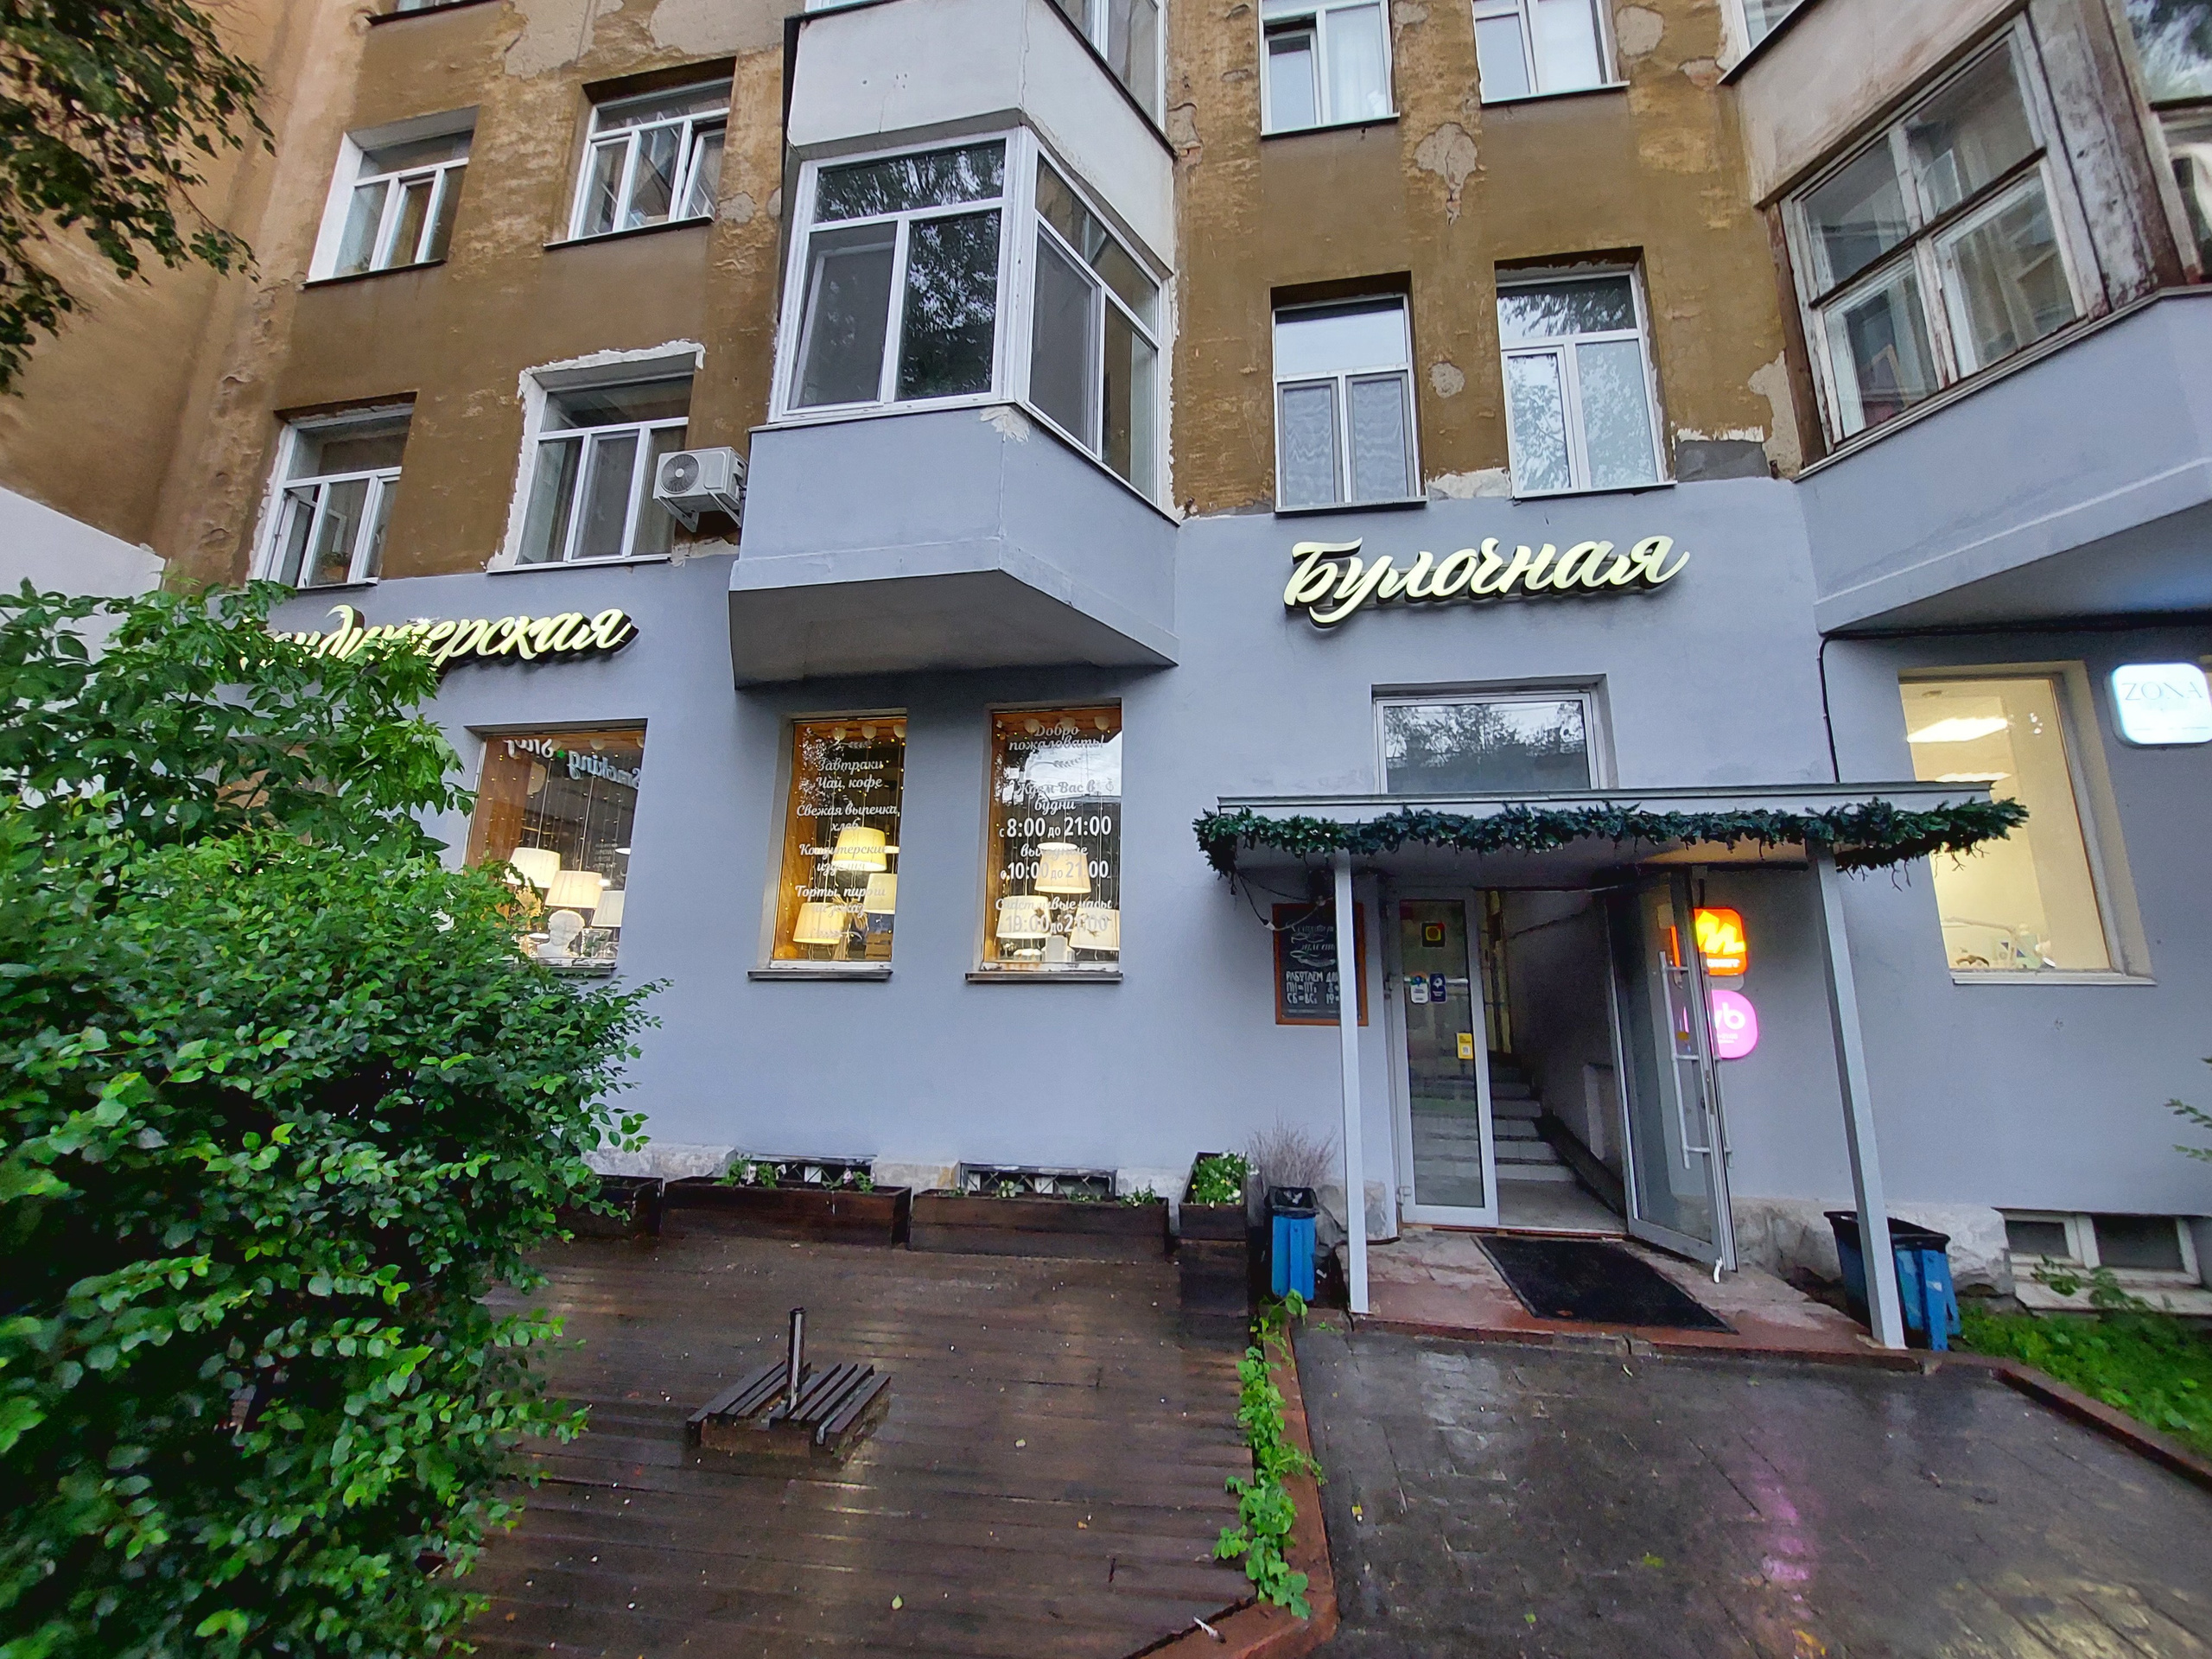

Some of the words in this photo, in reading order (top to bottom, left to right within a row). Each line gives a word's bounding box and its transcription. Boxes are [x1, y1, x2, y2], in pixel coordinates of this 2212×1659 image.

[1283, 535, 1690, 627] Булочная
[1034, 723, 1080, 738] Добро
[1009, 734, 1105, 751] пожаловать!
[817, 758, 883, 772] Завтраки
[817, 777, 846, 790] Чай,
[849, 777, 883, 794] кофе
[1058, 780, 1084, 793] Вас
[1087, 779, 1096, 793] в
[797, 804, 842, 817] Свежая
[1034, 798, 1077, 815] будни
[830, 817, 860, 831] хлеб
[999, 828, 1005, 838] с
[1007, 817, 1046, 838] 8:00
[1047, 825, 1061, 839] до
[1065, 815, 1112, 836] 21:00
[799, 843, 887, 861] Кондитерские
[1020, 843, 1088, 861] выхдные
[1007, 861, 1049, 880] 10:00
[1051, 870, 1064, 880] до
[1065, 861, 1109, 879] 21:00
[1078, 899, 1113, 911] часы
[1051, 922, 1064, 934] до
[1286, 970, 1323, 982] РАБОТАЕМ
